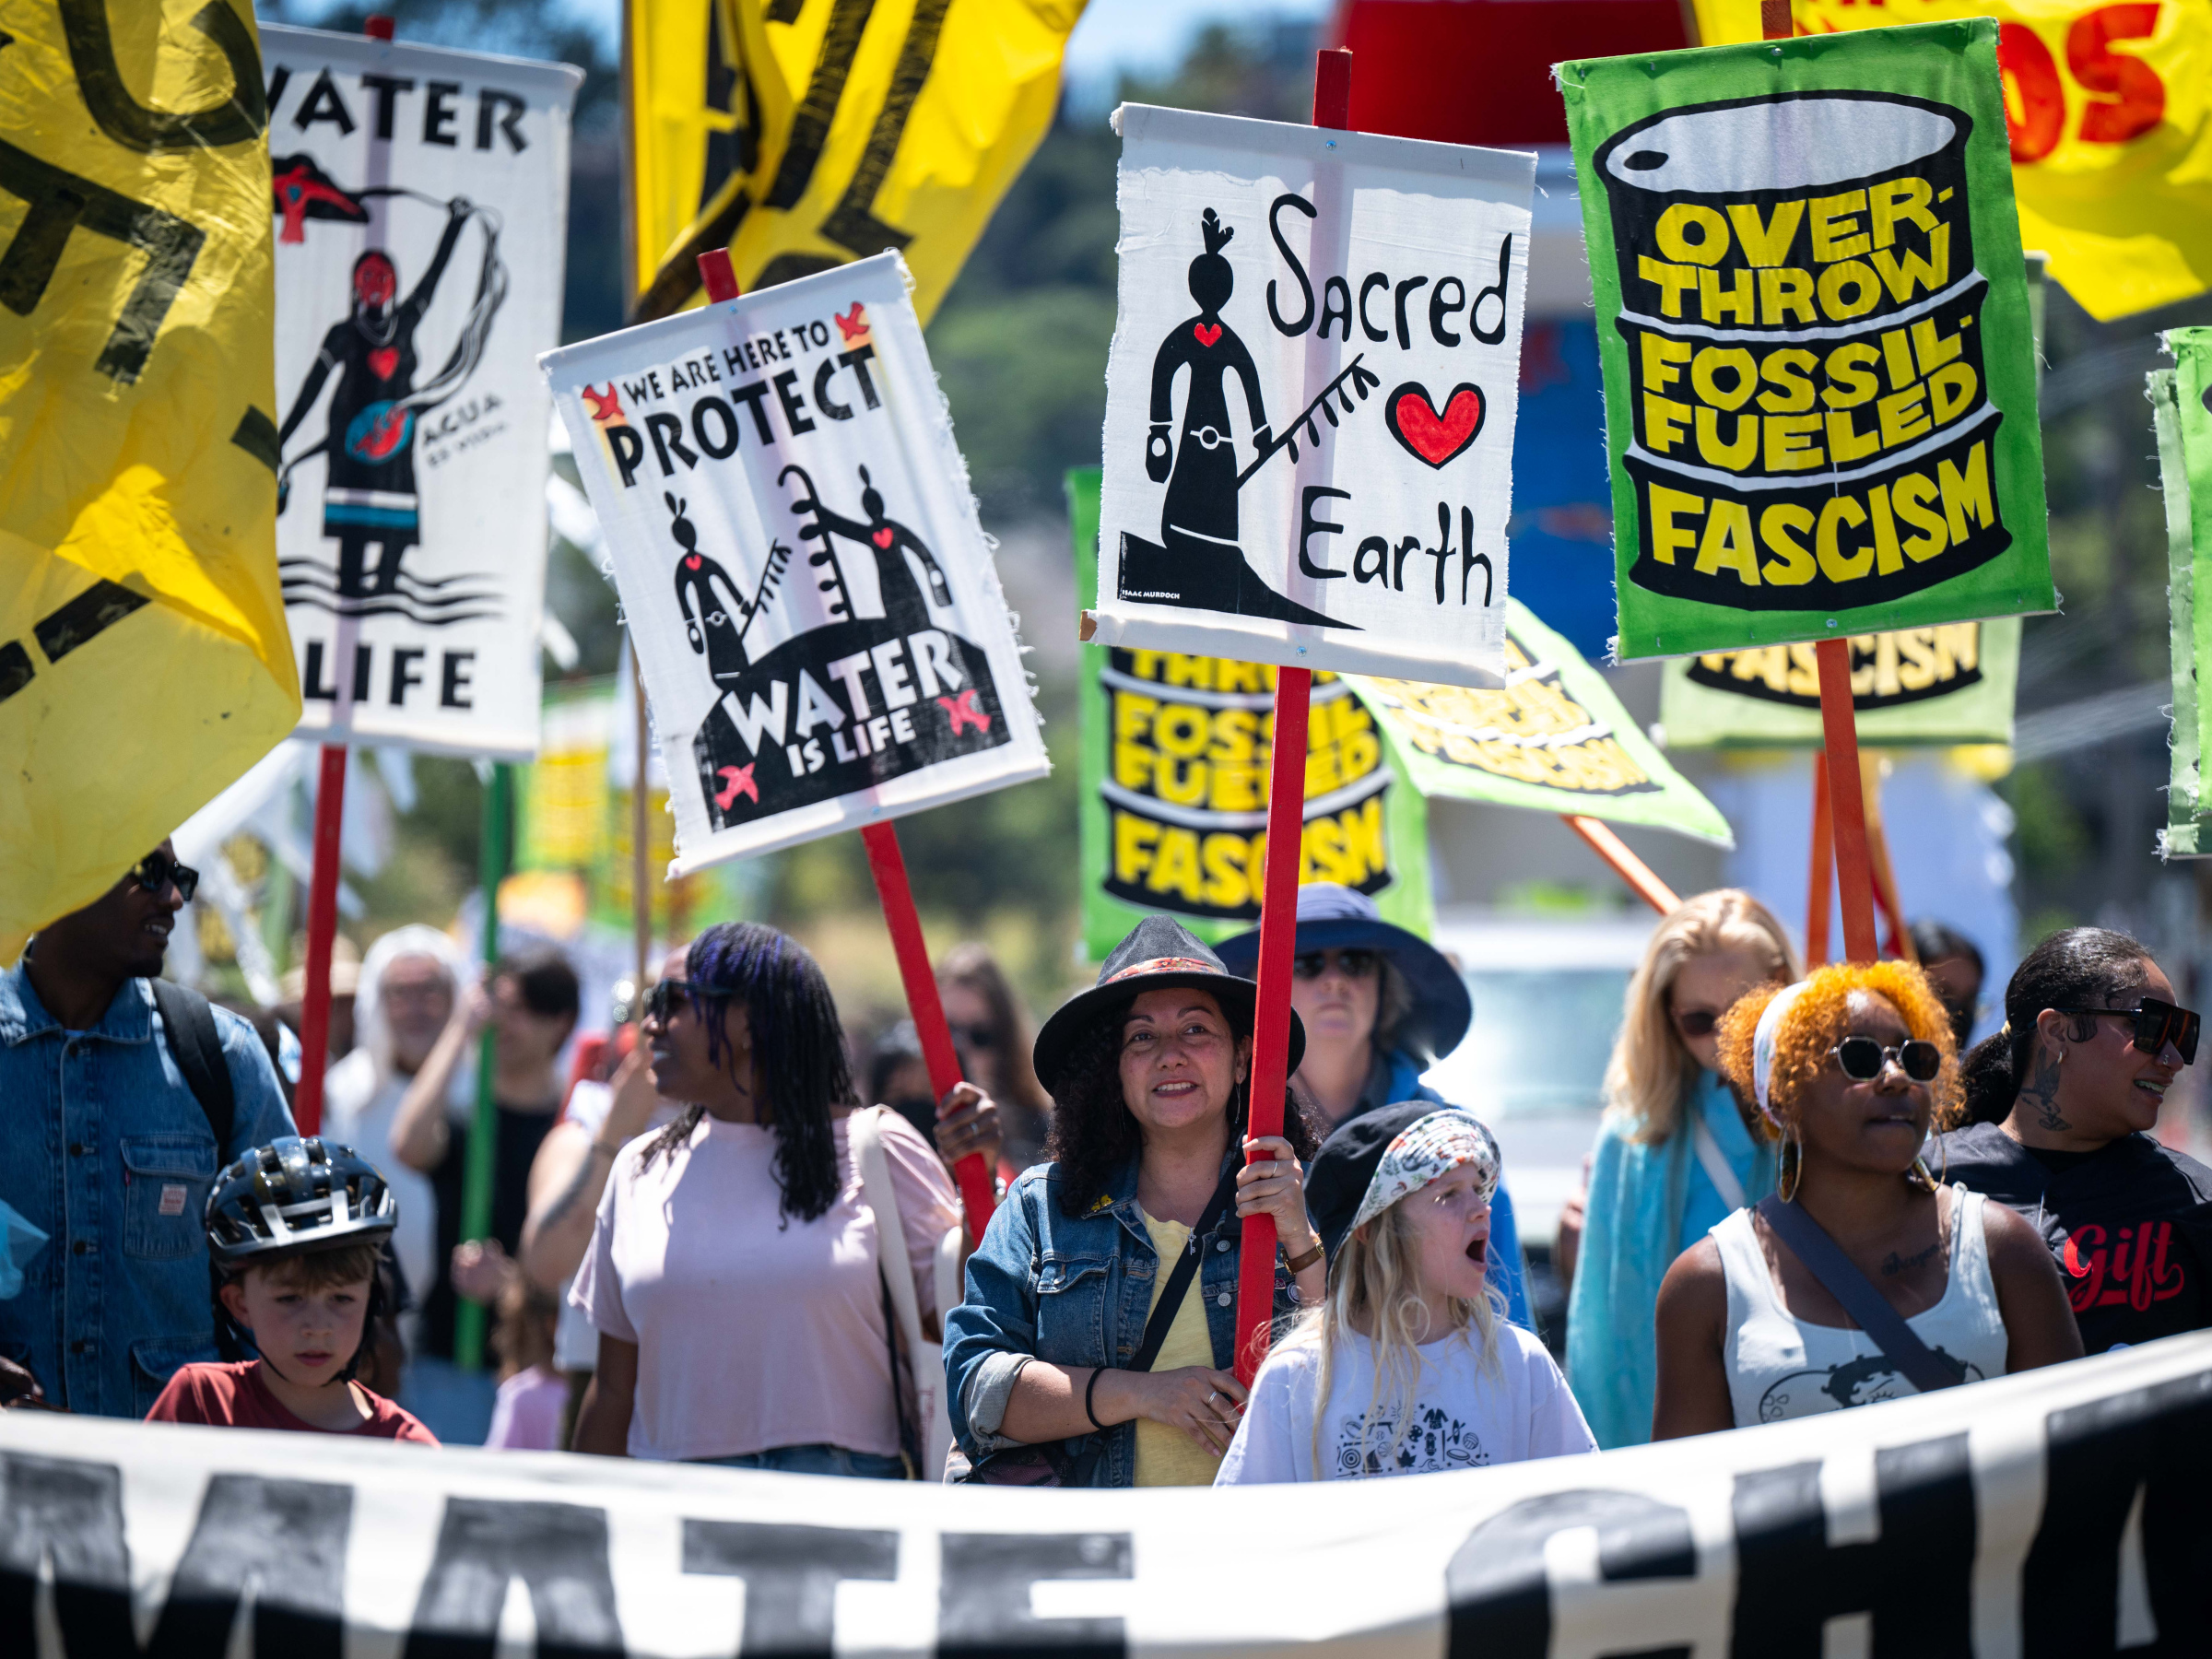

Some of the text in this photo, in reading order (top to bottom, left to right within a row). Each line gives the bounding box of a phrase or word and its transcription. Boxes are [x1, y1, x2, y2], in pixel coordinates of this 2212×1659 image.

[1655, 176, 1954, 267] OVER-
[1638, 222, 1950, 324] THROW
[622, 320, 830, 407] WE ARE HERE TO
[1641, 314, 1974, 412] FOSSIL-
[606, 344, 883, 488] PROTECT
[1642, 361, 1978, 472] FUELED
[1299, 485, 1493, 606] Earth
[1648, 441, 1996, 586] FASCISM
[1122, 589, 1180, 600] ISAAC MURDOCH
[305, 640, 476, 710] LIFE
[722, 629, 963, 756] WATER
[786, 708, 916, 777] IS LIFE
[2064, 1220, 2184, 1312] Gift
